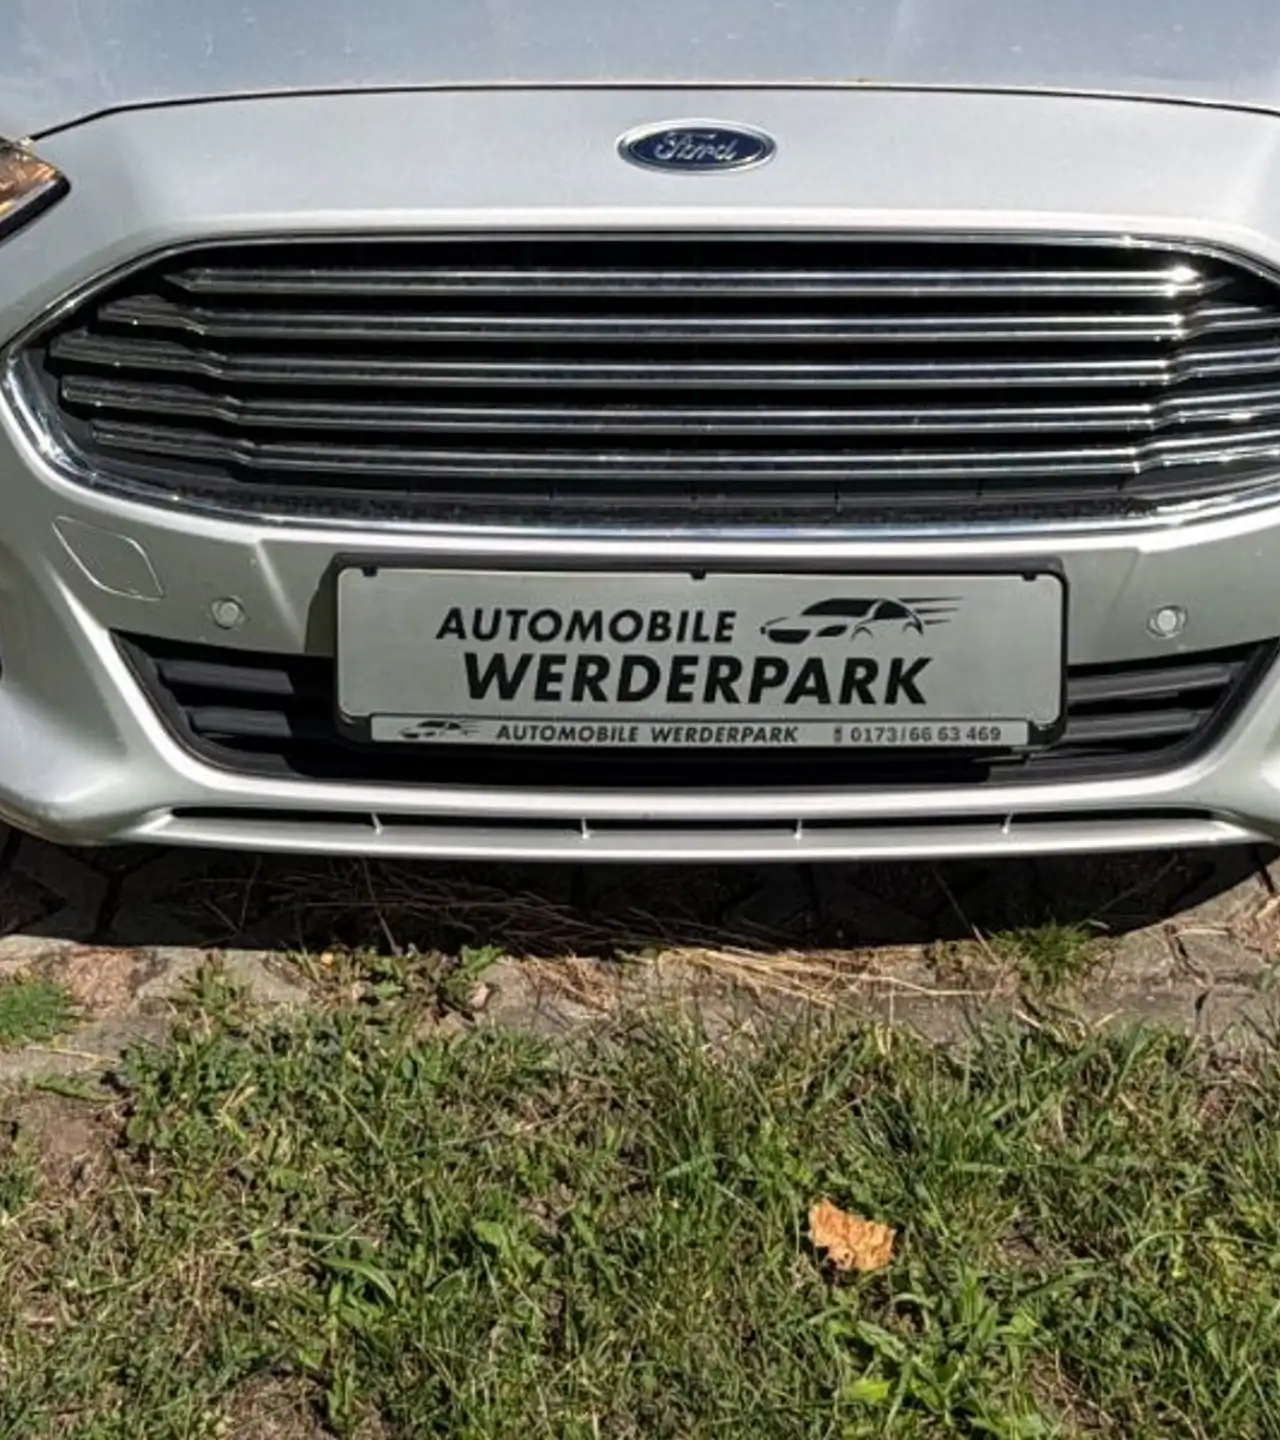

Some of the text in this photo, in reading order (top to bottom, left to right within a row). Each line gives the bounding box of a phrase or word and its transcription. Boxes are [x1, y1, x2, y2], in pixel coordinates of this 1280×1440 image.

[654, 131, 738, 161] Ford
[435, 606, 737, 644] AUTOMOBILE
[463, 652, 933, 705] WERDERPARK
[496, 724, 1002, 744] AUTOMOBILE WERDERPARK 0173/66 63 469
